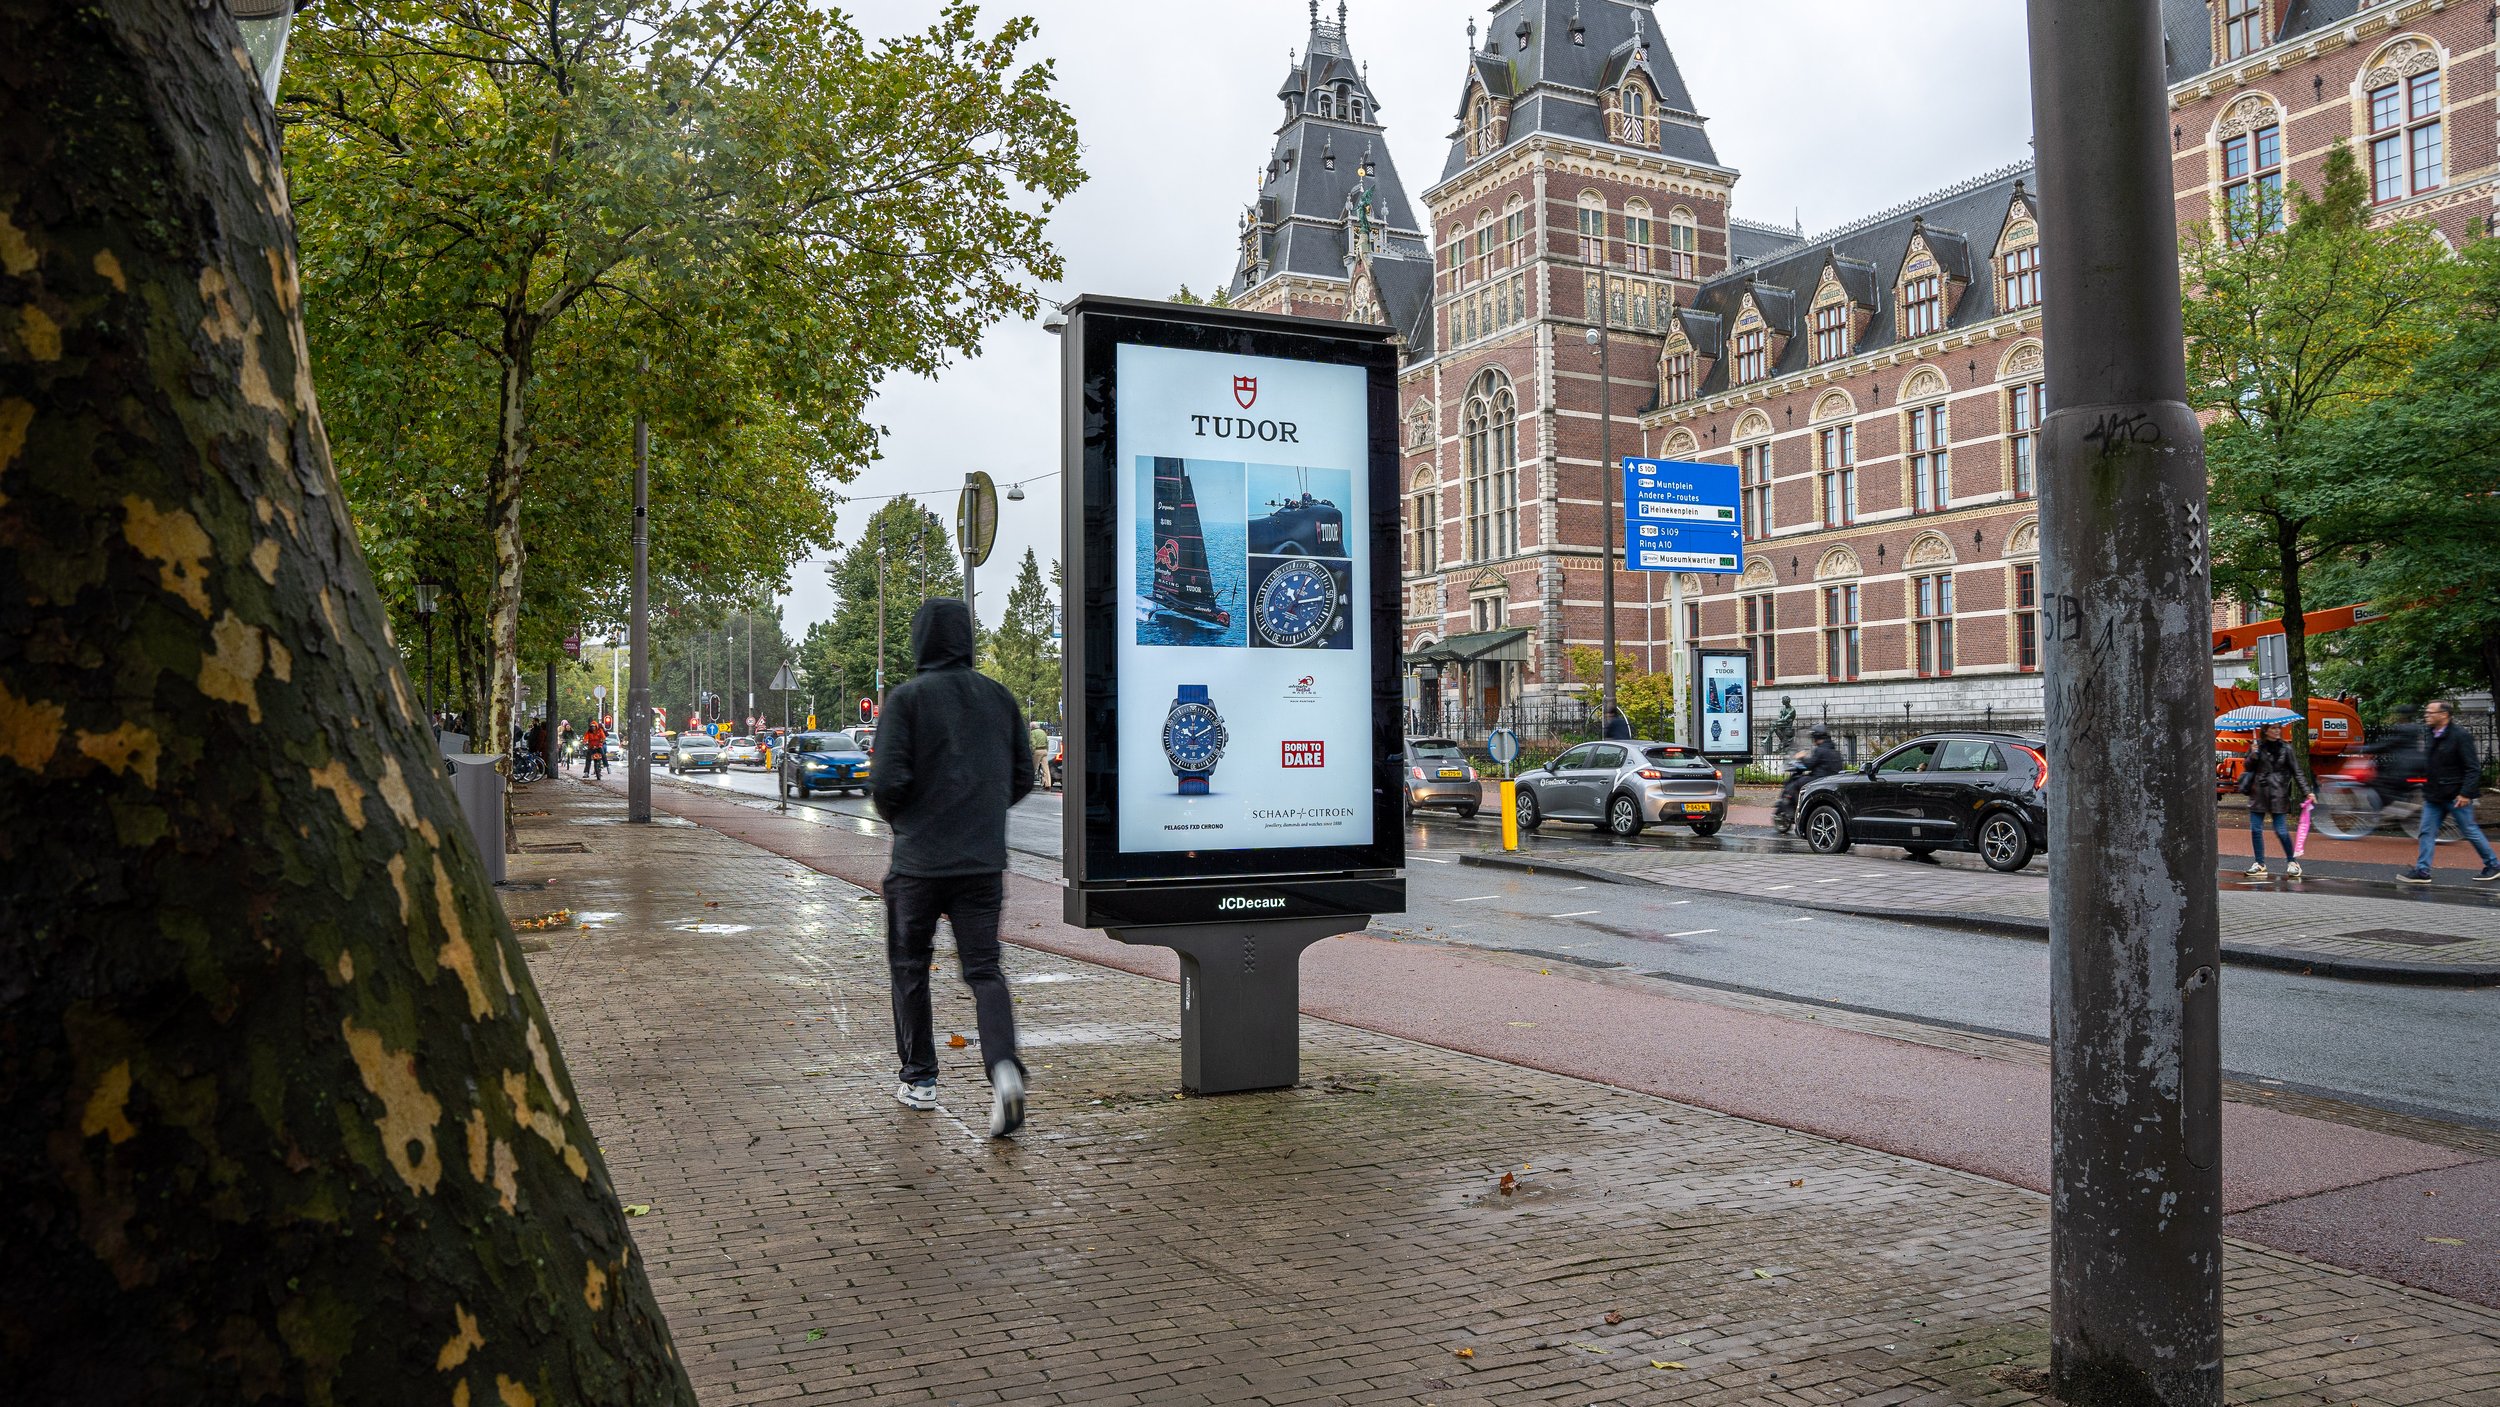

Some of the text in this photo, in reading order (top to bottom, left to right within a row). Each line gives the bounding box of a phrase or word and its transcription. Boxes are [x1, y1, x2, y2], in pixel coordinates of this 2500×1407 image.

[1191, 415, 1299, 443] TUDOR
[1656, 480, 1693, 490] Muntplein
[1638, 490, 1664, 499] Andere
[1650, 505, 1699, 515] Heinekenplein
[1321, 523, 1338, 541] TUDOR
[1639, 540, 1672, 550] Ring A10
[1660, 555, 1716, 564] Museumkwartier
[1186, 585, 1202, 593] TUDOR
[2324, 721, 2347, 729] Boels
[1284, 743, 1321, 752] BORN TO
[1284, 752, 1322, 766] DARE
[1252, 809, 1296, 819] SCHAAP
[1308, 808, 1354, 818] CITROEN
[1218, 897, 1286, 910] JCDecaux
